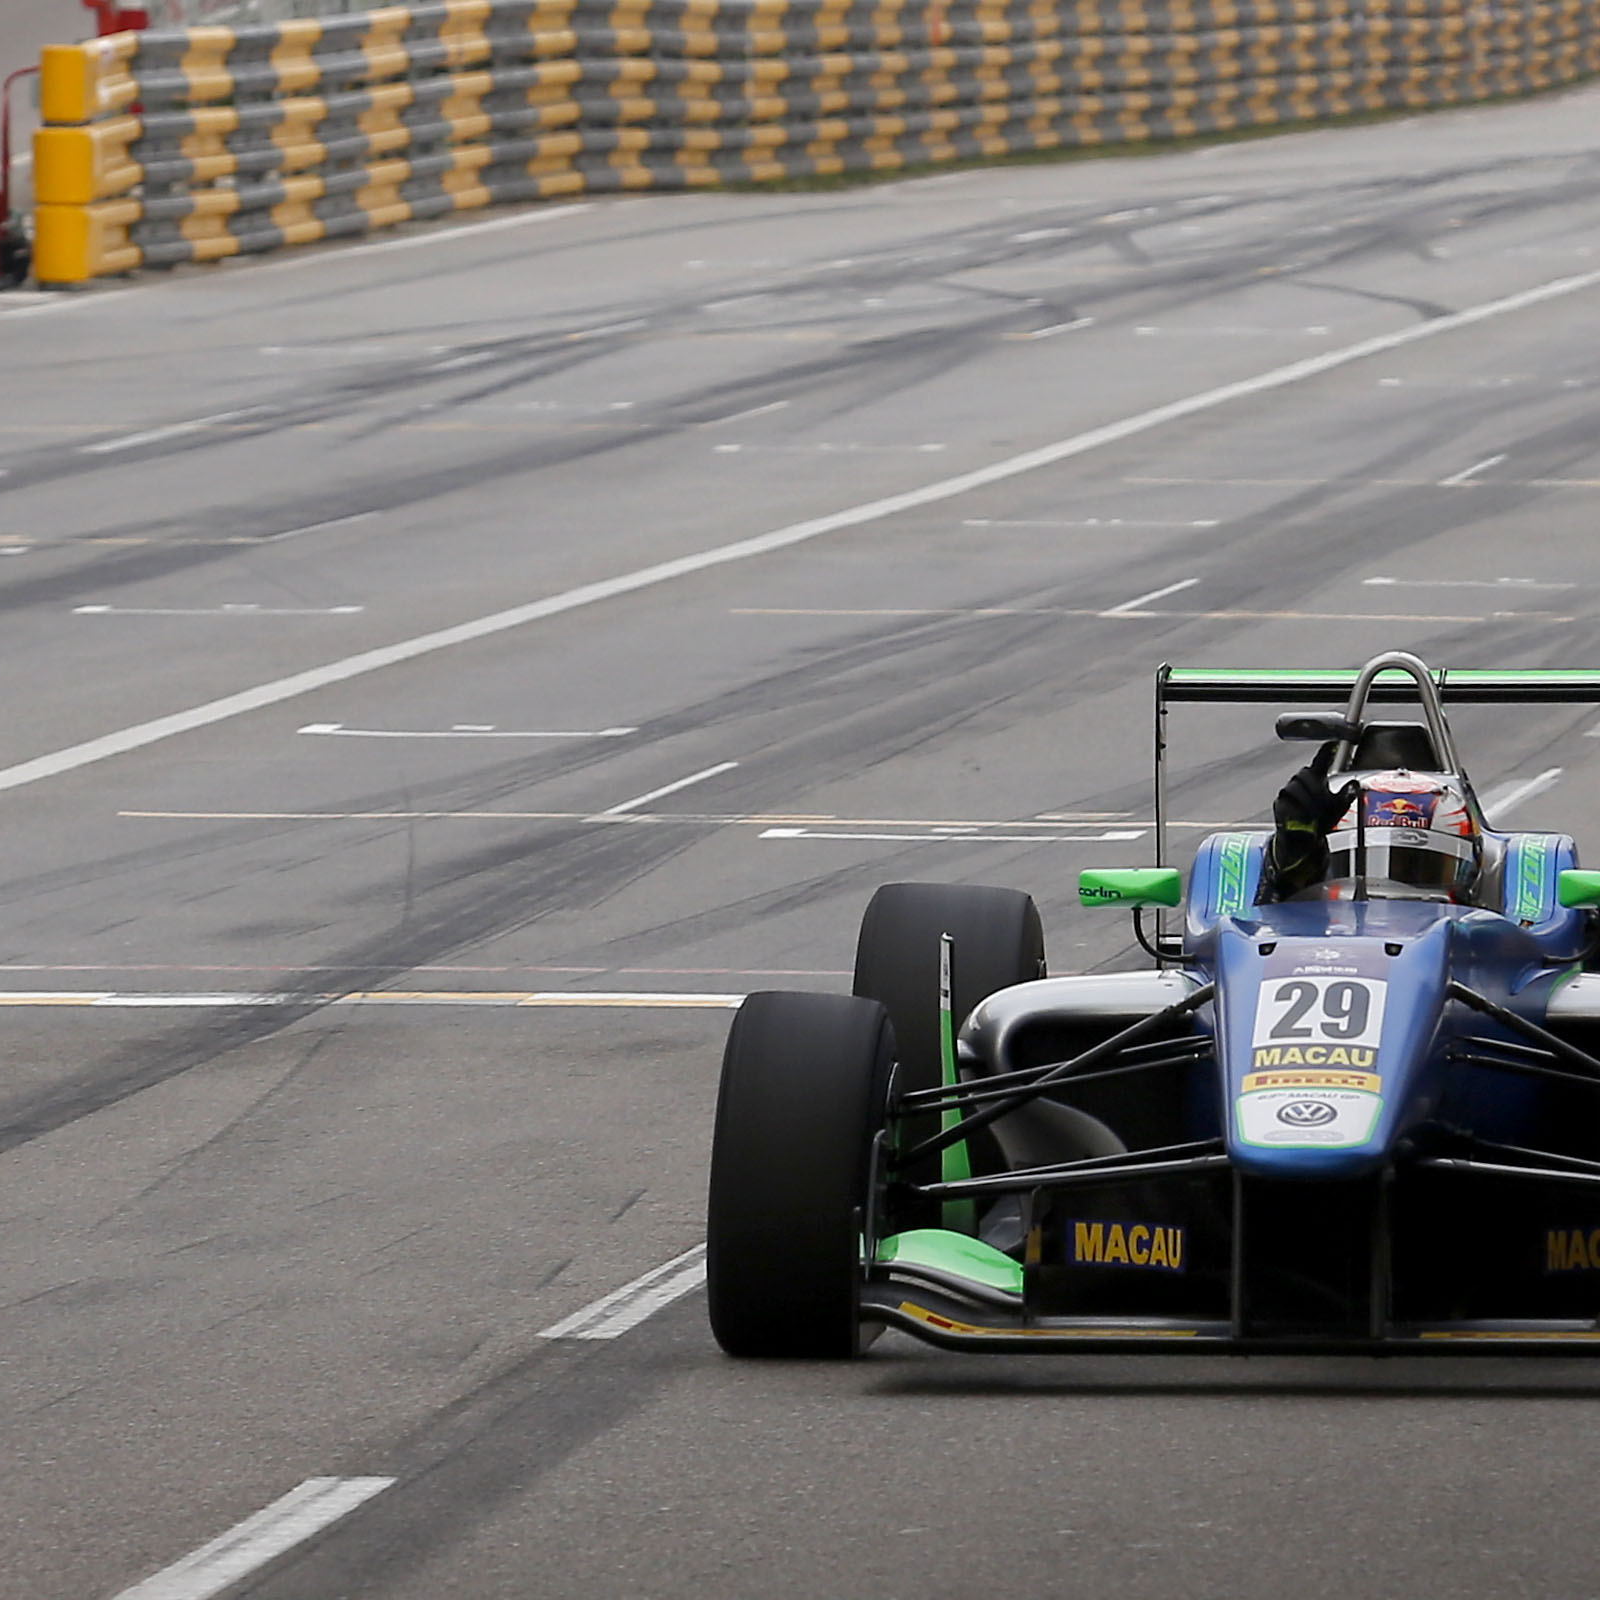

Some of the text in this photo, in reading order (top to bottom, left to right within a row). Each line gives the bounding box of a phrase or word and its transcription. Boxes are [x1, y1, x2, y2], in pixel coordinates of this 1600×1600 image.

[1368, 814, 1429, 828] Red Bull
[1078, 886, 1121, 899] carlin
[1269, 980, 1371, 1040] 29
[1254, 1046, 1374, 1068] MACAU
[1074, 1221, 1182, 1269] MACAU
